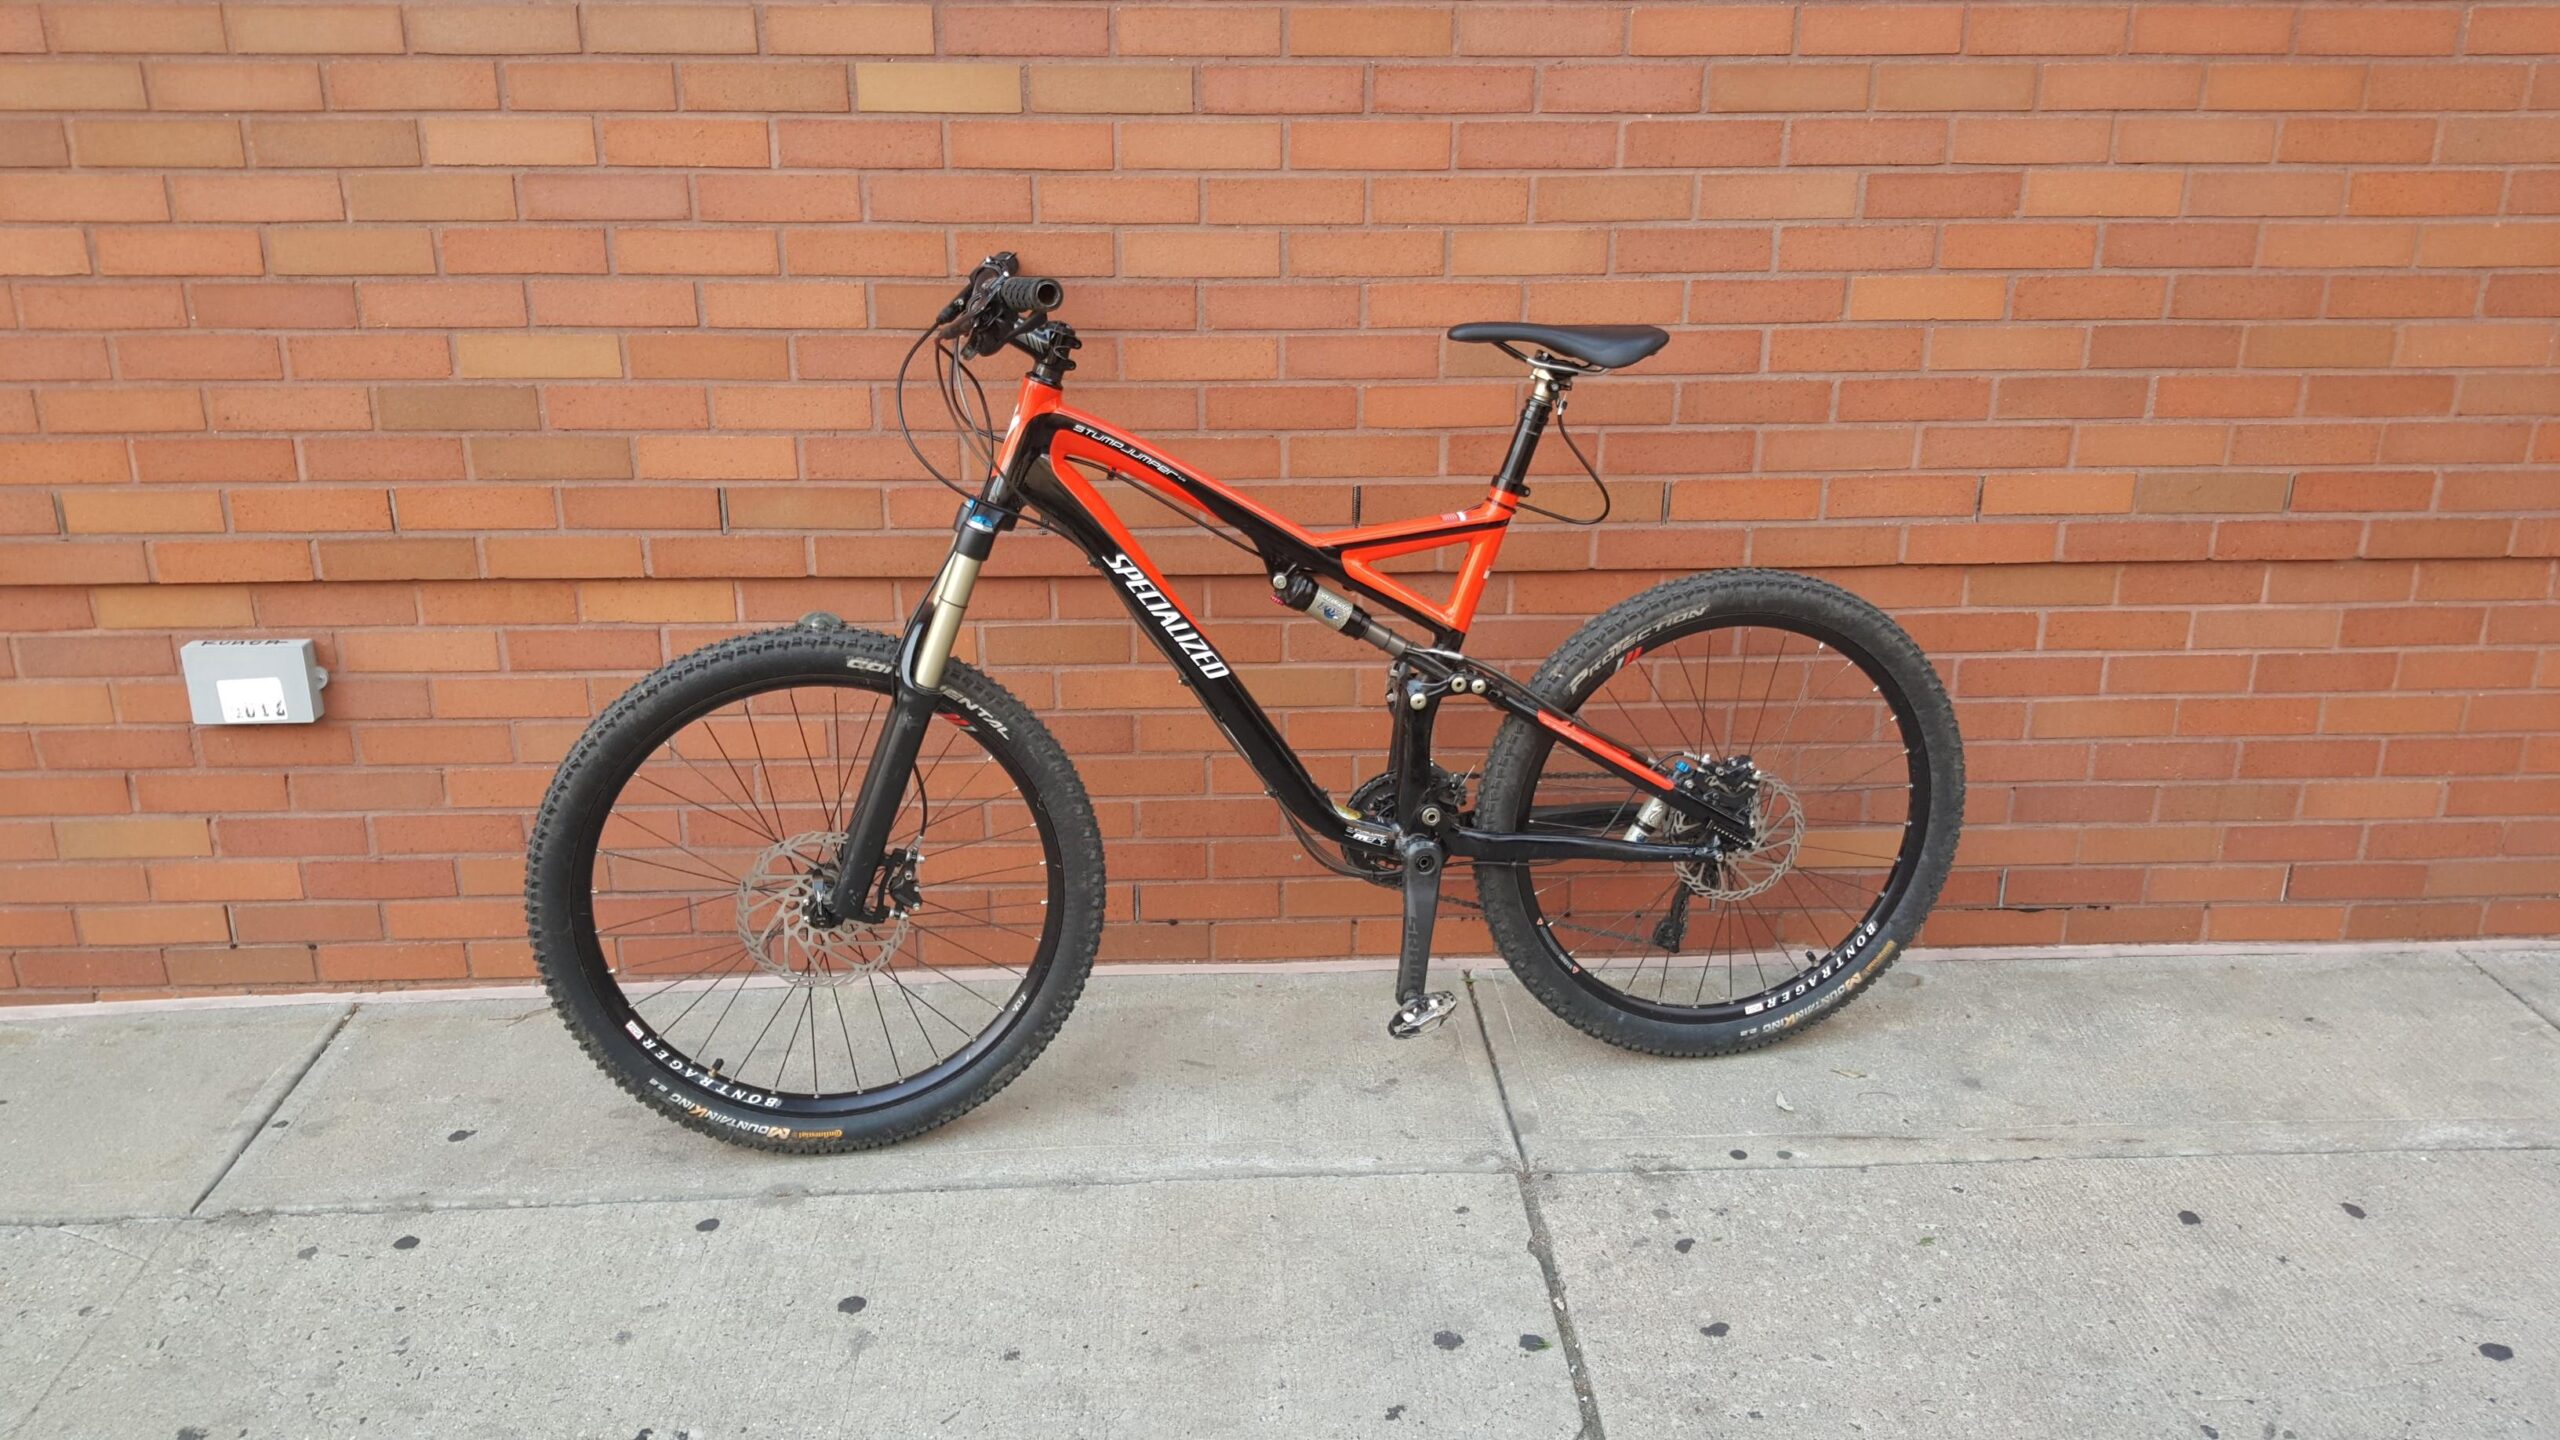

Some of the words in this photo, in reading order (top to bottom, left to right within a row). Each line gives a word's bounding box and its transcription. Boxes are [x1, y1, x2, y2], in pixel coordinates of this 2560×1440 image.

[1073, 424, 1179, 477] STUMPJUMPER
[1102, 553, 1230, 680] SPECIALIZED
[1568, 606, 1708, 695] PROTECTION
[1766, 921, 1877, 1008] BONTRAGER
[642, 1037, 783, 1108] BONTRAGER
